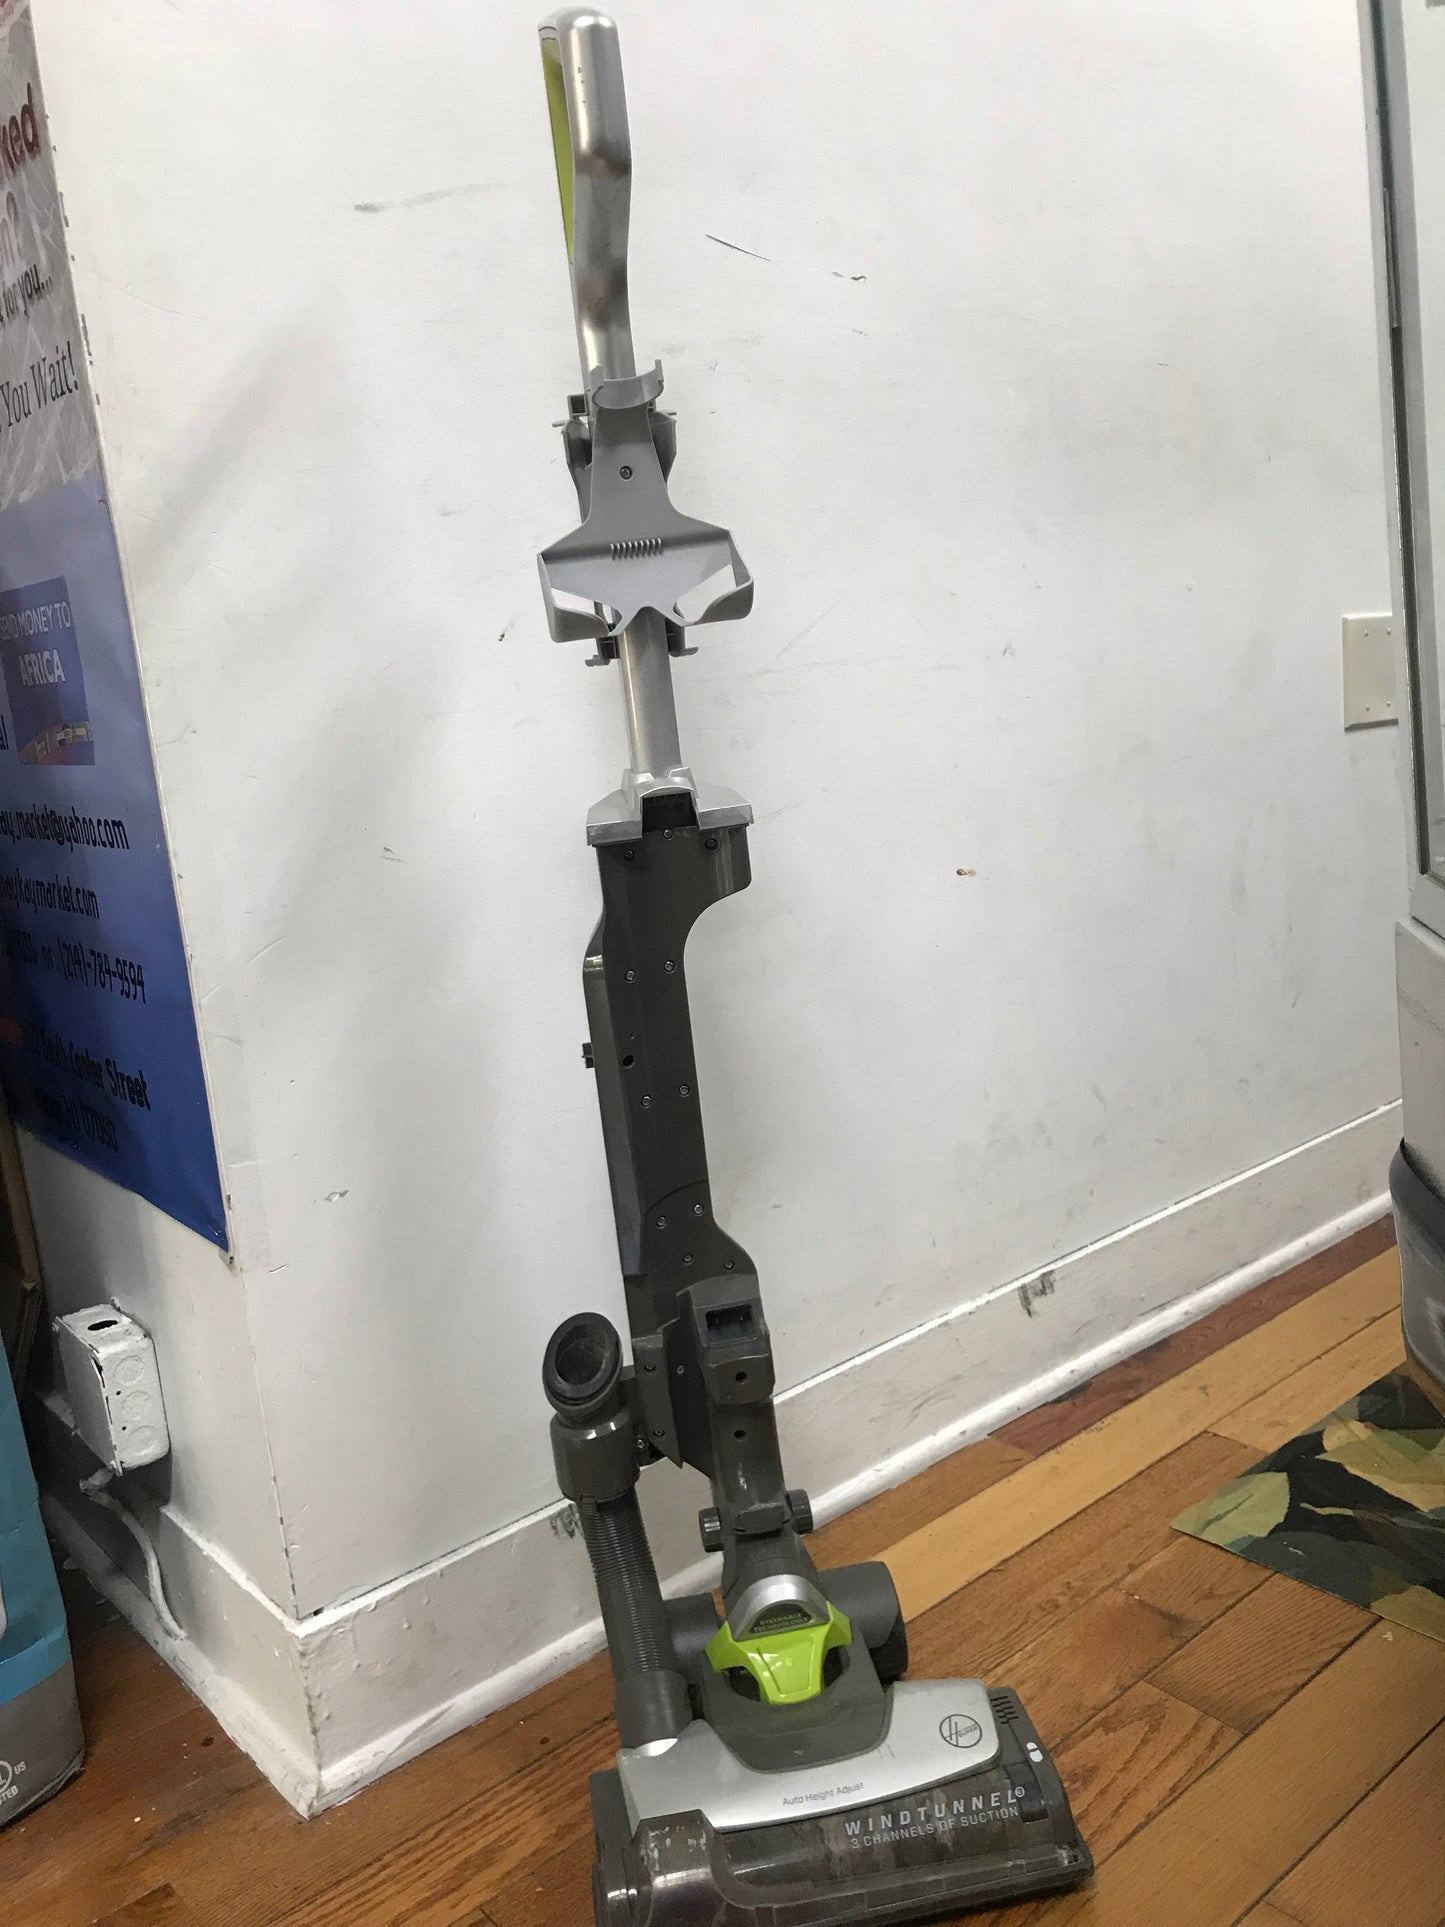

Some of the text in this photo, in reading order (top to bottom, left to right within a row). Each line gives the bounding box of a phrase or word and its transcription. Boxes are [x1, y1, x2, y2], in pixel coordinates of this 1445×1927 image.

[0, 341, 79, 428] You Wait!
[17, 606, 53, 636] MONEY
[53, 601, 72, 630] TO
[19, 649, 66, 687] AFRICA
[104, 1056, 151, 1111] Street
[13, 1761, 27, 1775] US
[782, 1781, 864, 1806] Auto Height Adjust
[845, 1789, 1017, 1836] WINDTUNNEL
[850, 1806, 1019, 1849] 3 CHANNELS OF SUCTION
